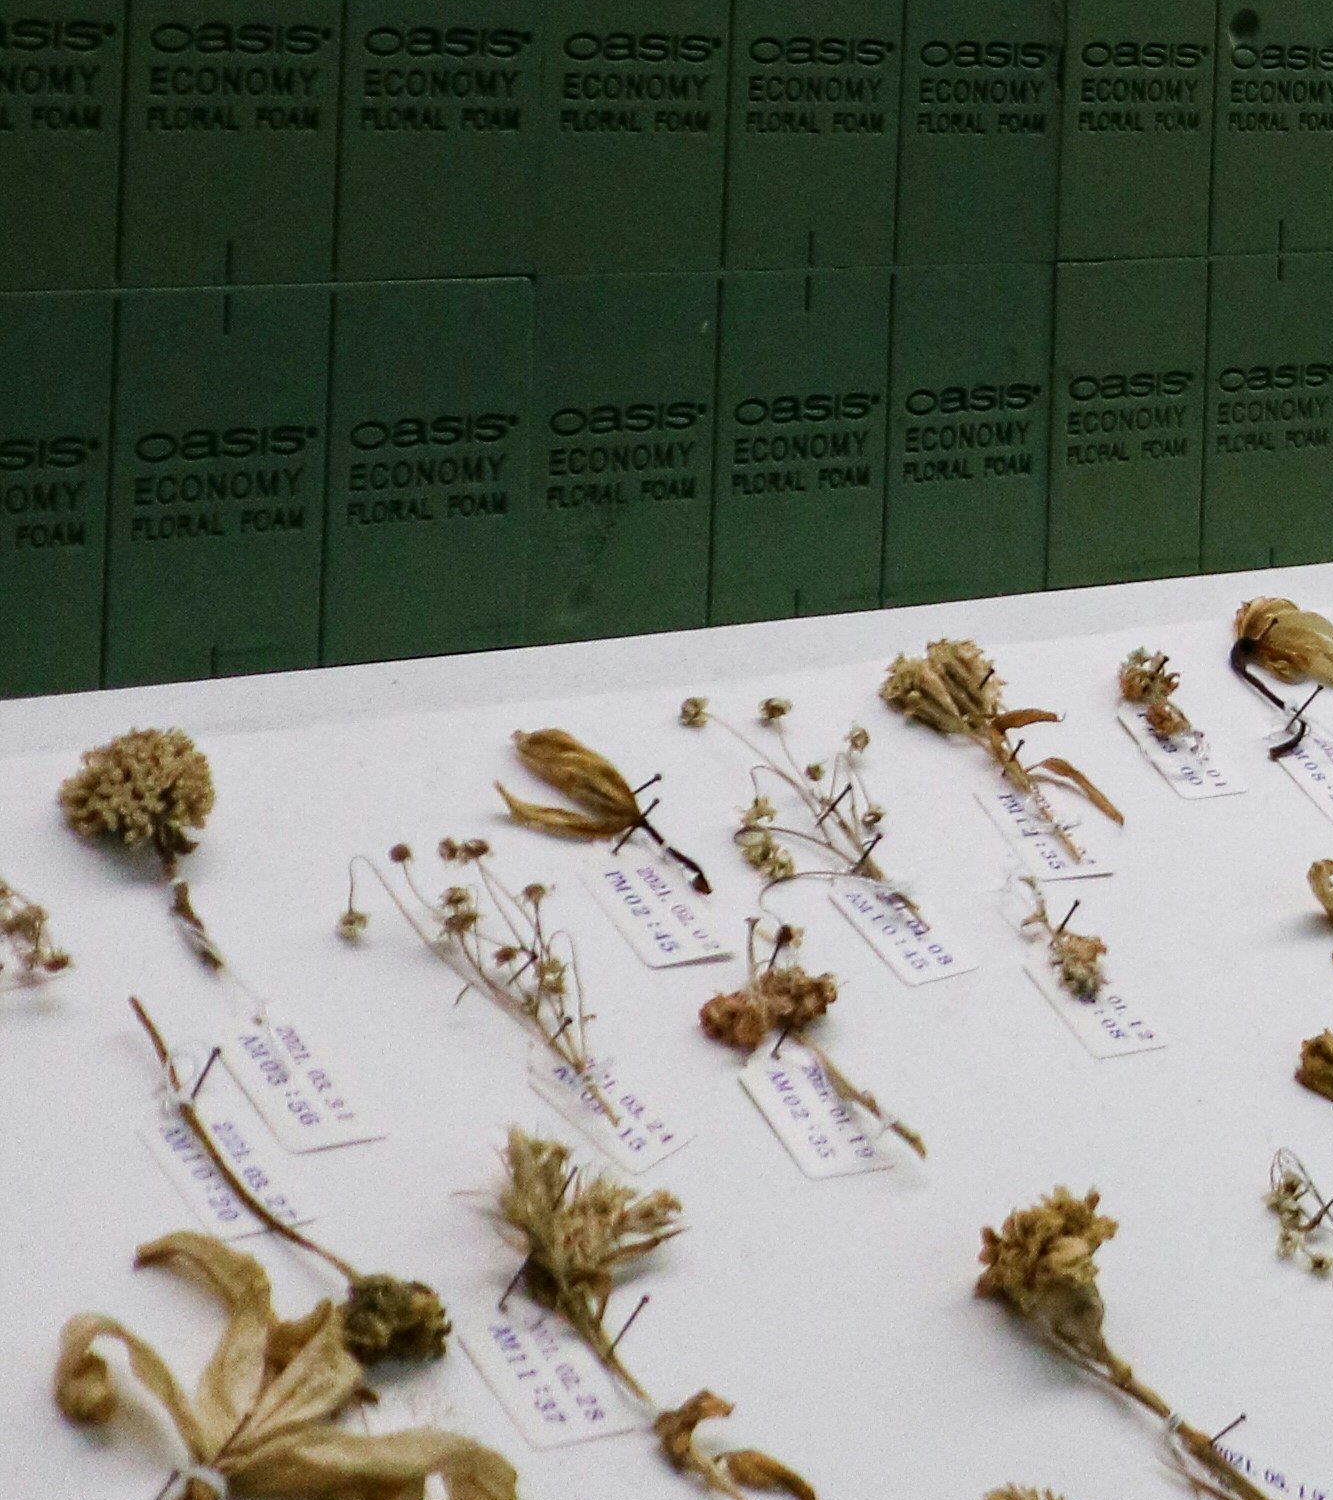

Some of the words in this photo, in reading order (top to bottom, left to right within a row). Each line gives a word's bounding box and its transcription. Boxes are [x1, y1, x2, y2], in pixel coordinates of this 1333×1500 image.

[151, 67, 319, 94] ECONOMY
[147, 106, 239, 130] FLORAL
[255, 106, 321, 129] FOAM
[350, 454, 507, 491] ECONOMY
[347, 499, 433, 525] FLORAL
[448, 493, 509, 517] FOAM
